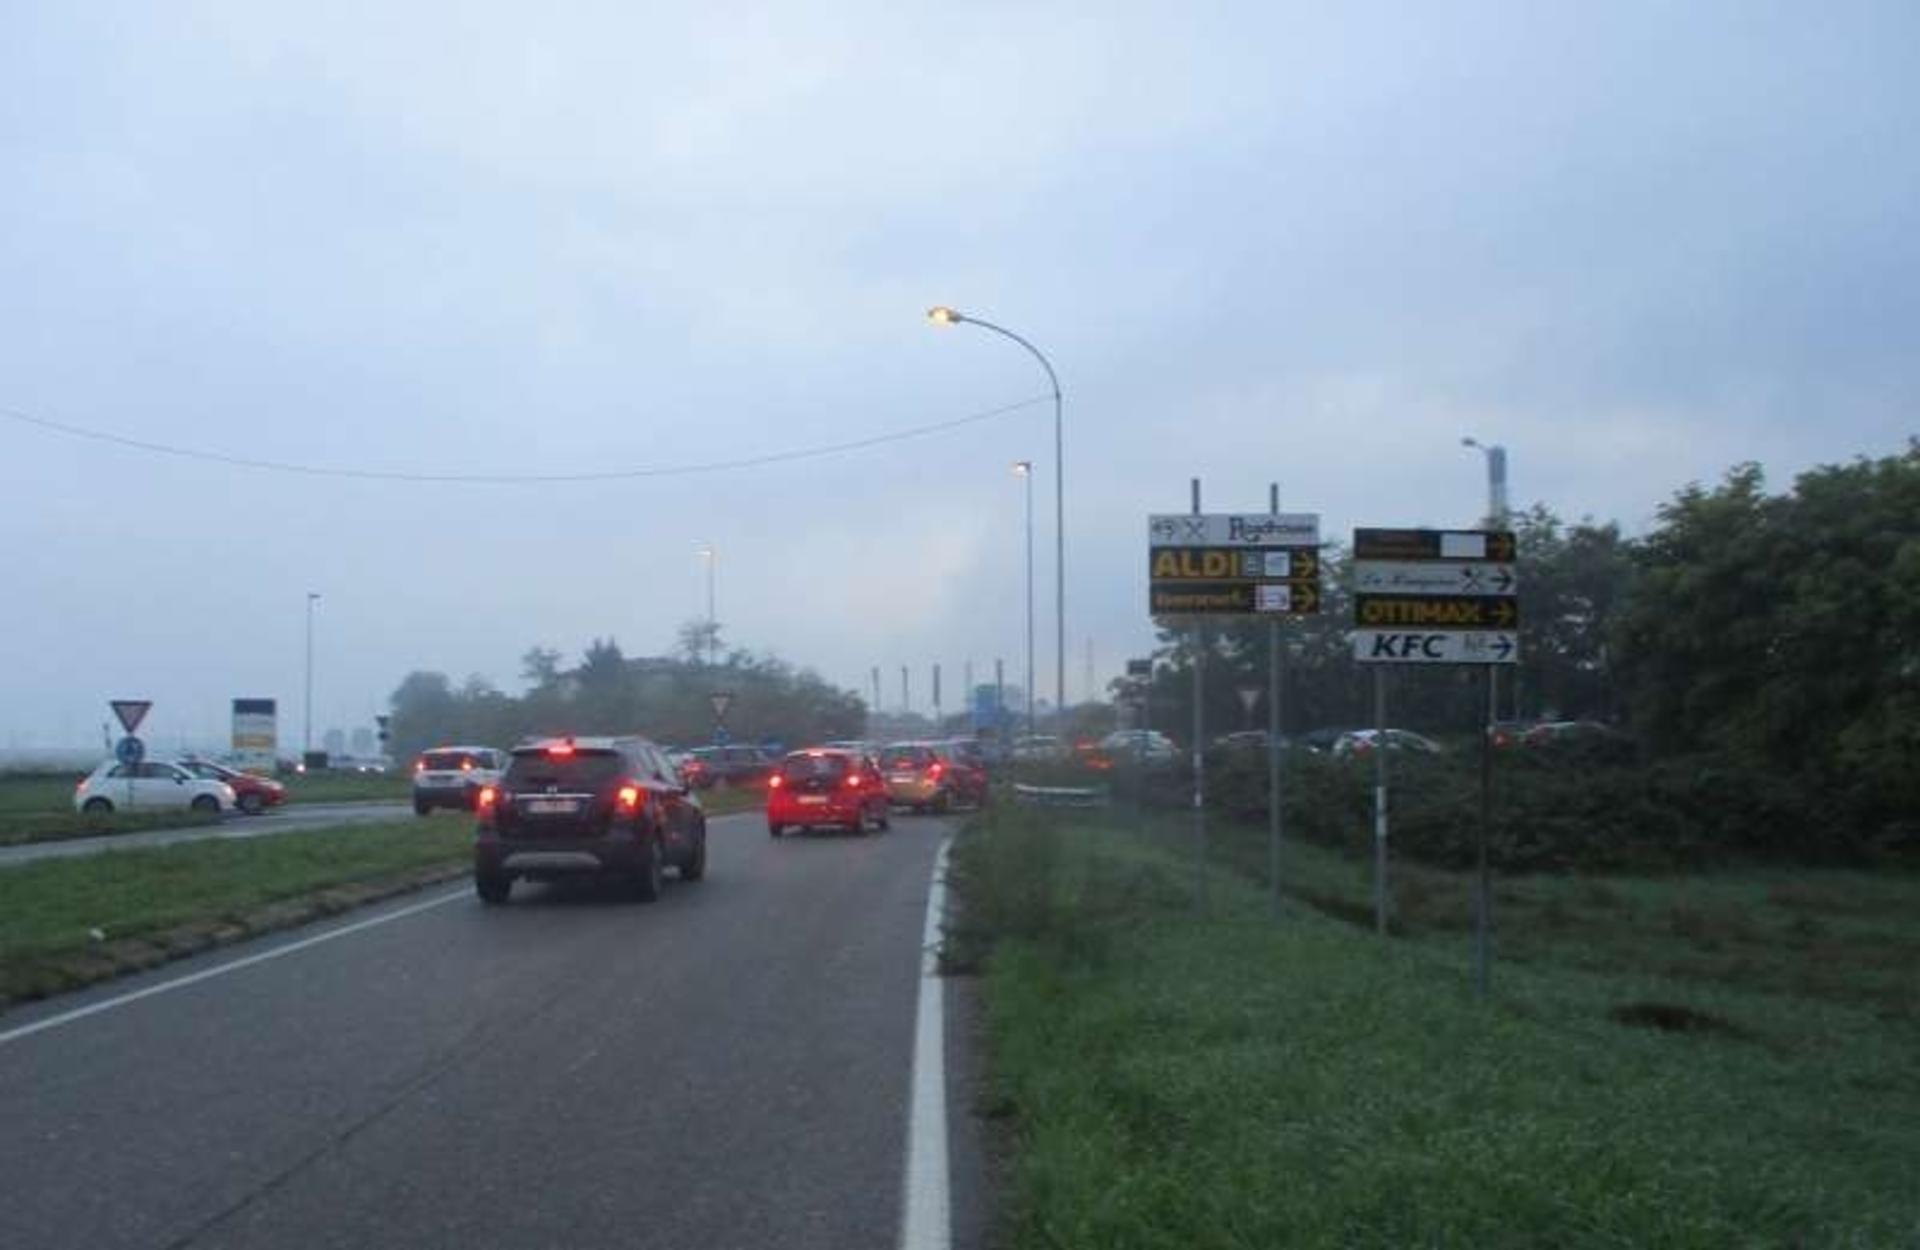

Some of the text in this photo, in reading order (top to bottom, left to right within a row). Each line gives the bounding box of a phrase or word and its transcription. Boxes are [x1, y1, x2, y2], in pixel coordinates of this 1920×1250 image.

[1153, 550, 1238, 577] ALDI
[1362, 600, 1480, 623] OTTIMAX
[1371, 634, 1448, 658] KFC
